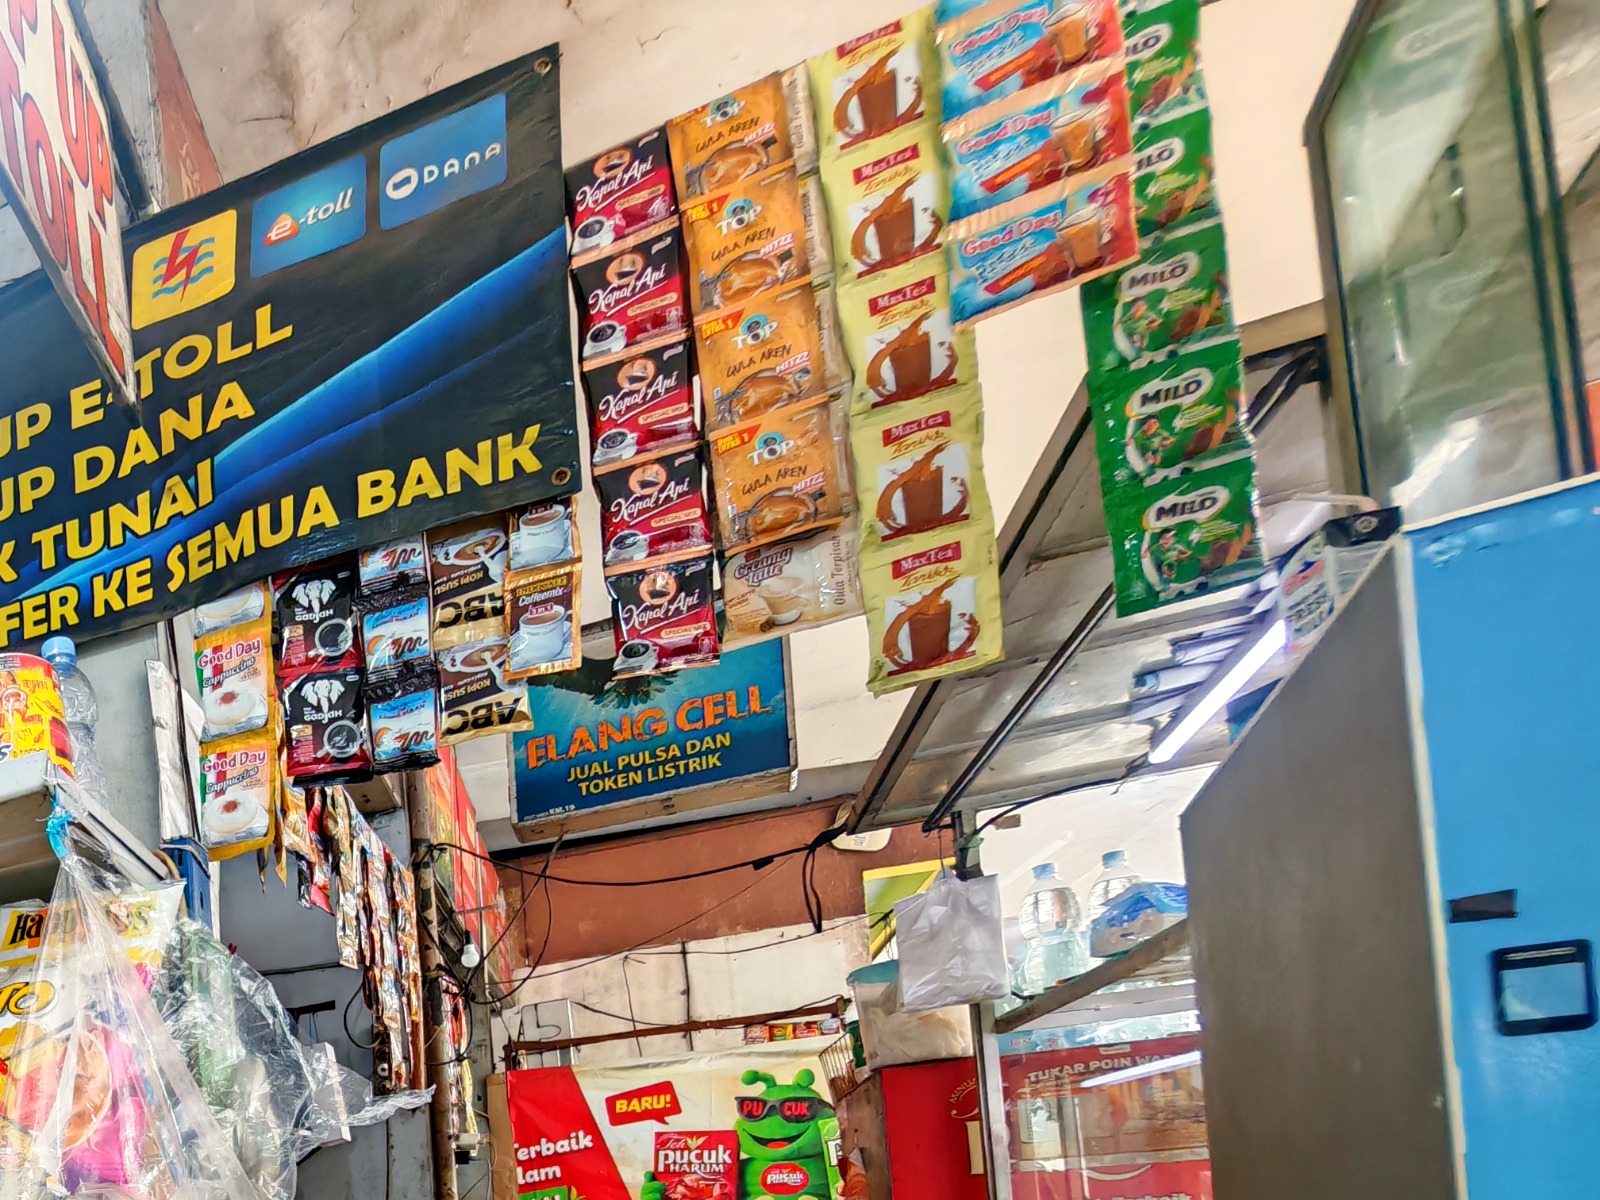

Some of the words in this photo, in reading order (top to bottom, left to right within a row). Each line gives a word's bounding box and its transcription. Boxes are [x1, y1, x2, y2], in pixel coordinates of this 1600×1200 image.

[422, 141, 501, 186] DANA
[576, 173, 623, 212] Kapal
[622, 155, 654, 187] Api
[266, 187, 353, 245] e-toll
[589, 282, 634, 315] Kapal
[635, 263, 666, 294] Api
[1127, 261, 1190, 291] MILO
[731, 321, 779, 350] TOP
[599, 383, 647, 422] Kapal
[646, 371, 678, 402] Api
[1139, 377, 1204, 408] MILO
[73, 382, 256, 497] DANA
[747, 438, 795, 468] TOP
[31, 461, 215, 568] TUNAI
[93, 560, 156, 621] KE
[167, 485, 341, 593] SEMUA
[357, 424, 544, 519] BANK
[610, 489, 660, 526] Kapal
[659, 477, 691, 506] Api
[1154, 494, 1220, 524] MILO
[734, 547, 794, 579] Creamy
[747, 565, 785, 589] Latte
[899, 546, 955, 572] MaxTea
[622, 603, 670, 635] Kapal
[669, 588, 700, 619] Api
[198, 648, 234, 669] Good
[235, 638, 262, 658] Day
[447, 696, 523, 736] ABC
[526, 707, 668, 770] ELANG
[675, 685, 773, 733] CELL
[202, 757, 238, 775] Good
[239, 749, 266, 767] Day
[567, 760, 613, 783] JUAL
[617, 743, 681, 772] PULSA
[685, 731, 732, 756] DAN
[578, 772, 644, 797] TOKEN
[647, 752, 723, 783] LISTRIK
[1027, 1062, 1087, 1084] TUKAR
[1088, 1055, 1133, 1072] POIN
[614, 1093, 672, 1115] BARU!
